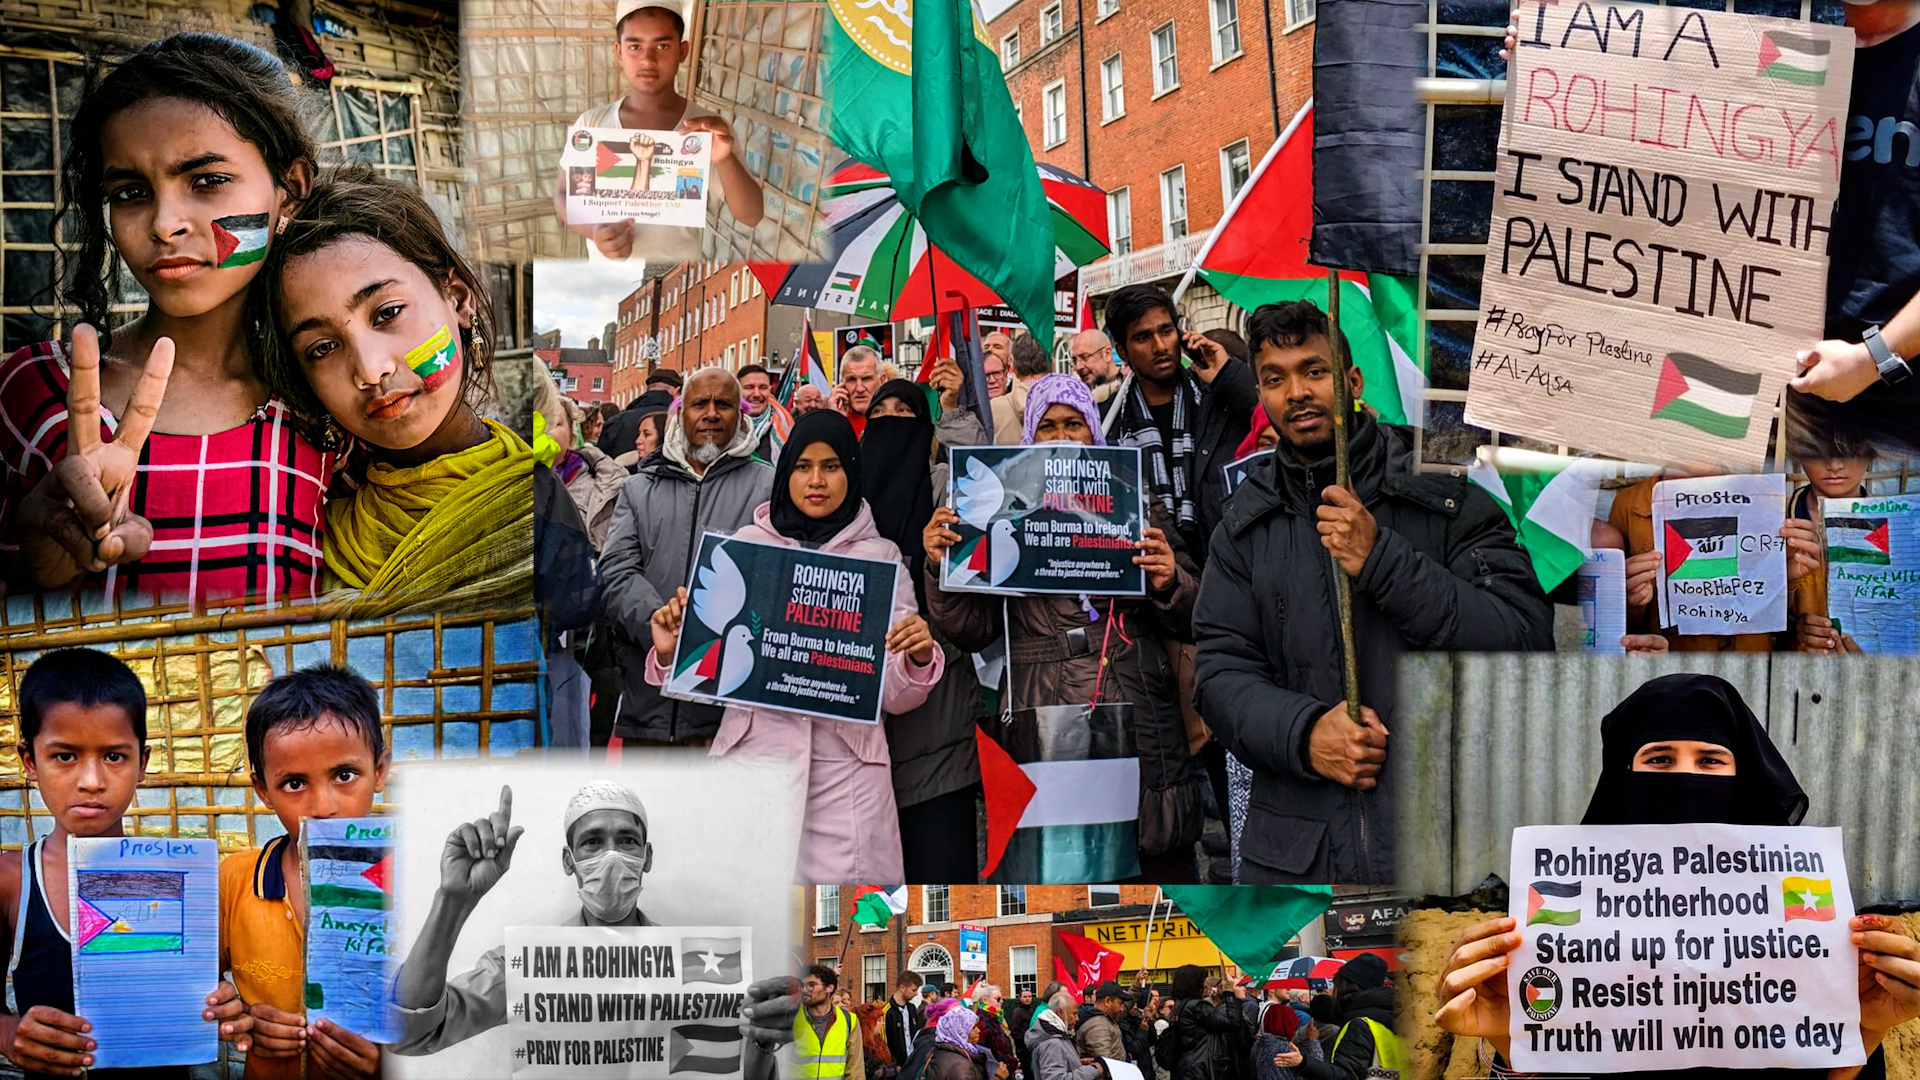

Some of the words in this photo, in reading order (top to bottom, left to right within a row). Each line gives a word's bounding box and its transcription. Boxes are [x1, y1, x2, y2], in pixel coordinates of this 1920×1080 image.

[1520, 0, 1551, 49] I
[1561, 1, 1644, 58] AM
[1662, 12, 1720, 69] A
[1524, 67, 1840, 181] ROHINGYA
[653, 157, 694, 167] Rohingya
[588, 199, 622, 207] Support
[624, 200, 662, 208] Palestine
[1503, 149, 1542, 201] I
[1557, 157, 1687, 227] STAND
[1712, 183, 1840, 256] WITH
[1502, 216, 1782, 329] PALESTINE
[1045, 459, 1112, 479] ROHINGYA
[1045, 477, 1080, 494] stand
[1083, 478, 1110, 496] with
[1042, 492, 1114, 513] PALESTINE
[1024, 519, 1049, 532] From
[1050, 520, 1082, 533] Burma
[1083, 522, 1094, 534] to
[1095, 521, 1132, 537] Ireland,
[1024, 533, 1039, 547] We
[1040, 533, 1053, 547] all
[1054, 536, 1071, 547] are
[1072, 534, 1135, 549] Palestinians.
[793, 563, 865, 595] ROHINGYA
[1039, 568, 1058, 577] threat
[1057, 568, 1064, 577] to
[1063, 568, 1085, 579] justice
[1076, 560, 1105, 570] anywhere
[1104, 561, 1111, 570] is
[791, 585, 830, 608] stand
[832, 590, 860, 613] with
[1678, 604, 1749, 623] Rohingya
[785, 601, 862, 633] PALESTINE
[761, 642, 777, 658] We
[777, 645, 792, 660] all
[792, 650, 810, 664] are
[810, 650, 876, 674] Palestinians.
[762, 627, 789, 645] From
[790, 631, 823, 652] Burma
[824, 638, 835, 652] to
[836, 639, 876, 661] Ireland,
[771, 681, 790, 692] threat
[790, 684, 797, 694] to
[796, 685, 819, 697] justice
[810, 678, 841, 692] anywhere
[840, 683, 848, 693] is
[1534, 846, 1664, 884] Rohingya
[1672, 844, 1824, 875] Palestinian
[1596, 884, 1769, 918] brotherhood
[511, 946, 529, 978] #I
[533, 946, 562, 978] AM
[566, 946, 579, 978] A
[582, 946, 676, 979] ROHINGYA
[1536, 930, 1621, 964] Stand
[1631, 935, 1666, 969] up
[1674, 928, 1715, 960] for
[1722, 927, 1829, 968] justice.
[1572, 974, 1664, 1008] Resist
[1672, 972, 1797, 1013] injustice
[513, 993, 530, 1022] #I
[535, 993, 594, 1023] STAND
[597, 993, 646, 1022] WITH
[650, 993, 745, 1022] PALESTINE
[515, 1039, 561, 1065] #PRAY
[564, 1039, 591, 1065] FOR
[594, 1036, 665, 1065] PALESTINE
[1524, 1021, 1602, 1052] Truth
[1612, 1019, 1663, 1052] will
[1673, 1017, 1724, 1049] win
[1734, 1022, 1786, 1049] one
[1796, 1016, 1845, 1055] day
